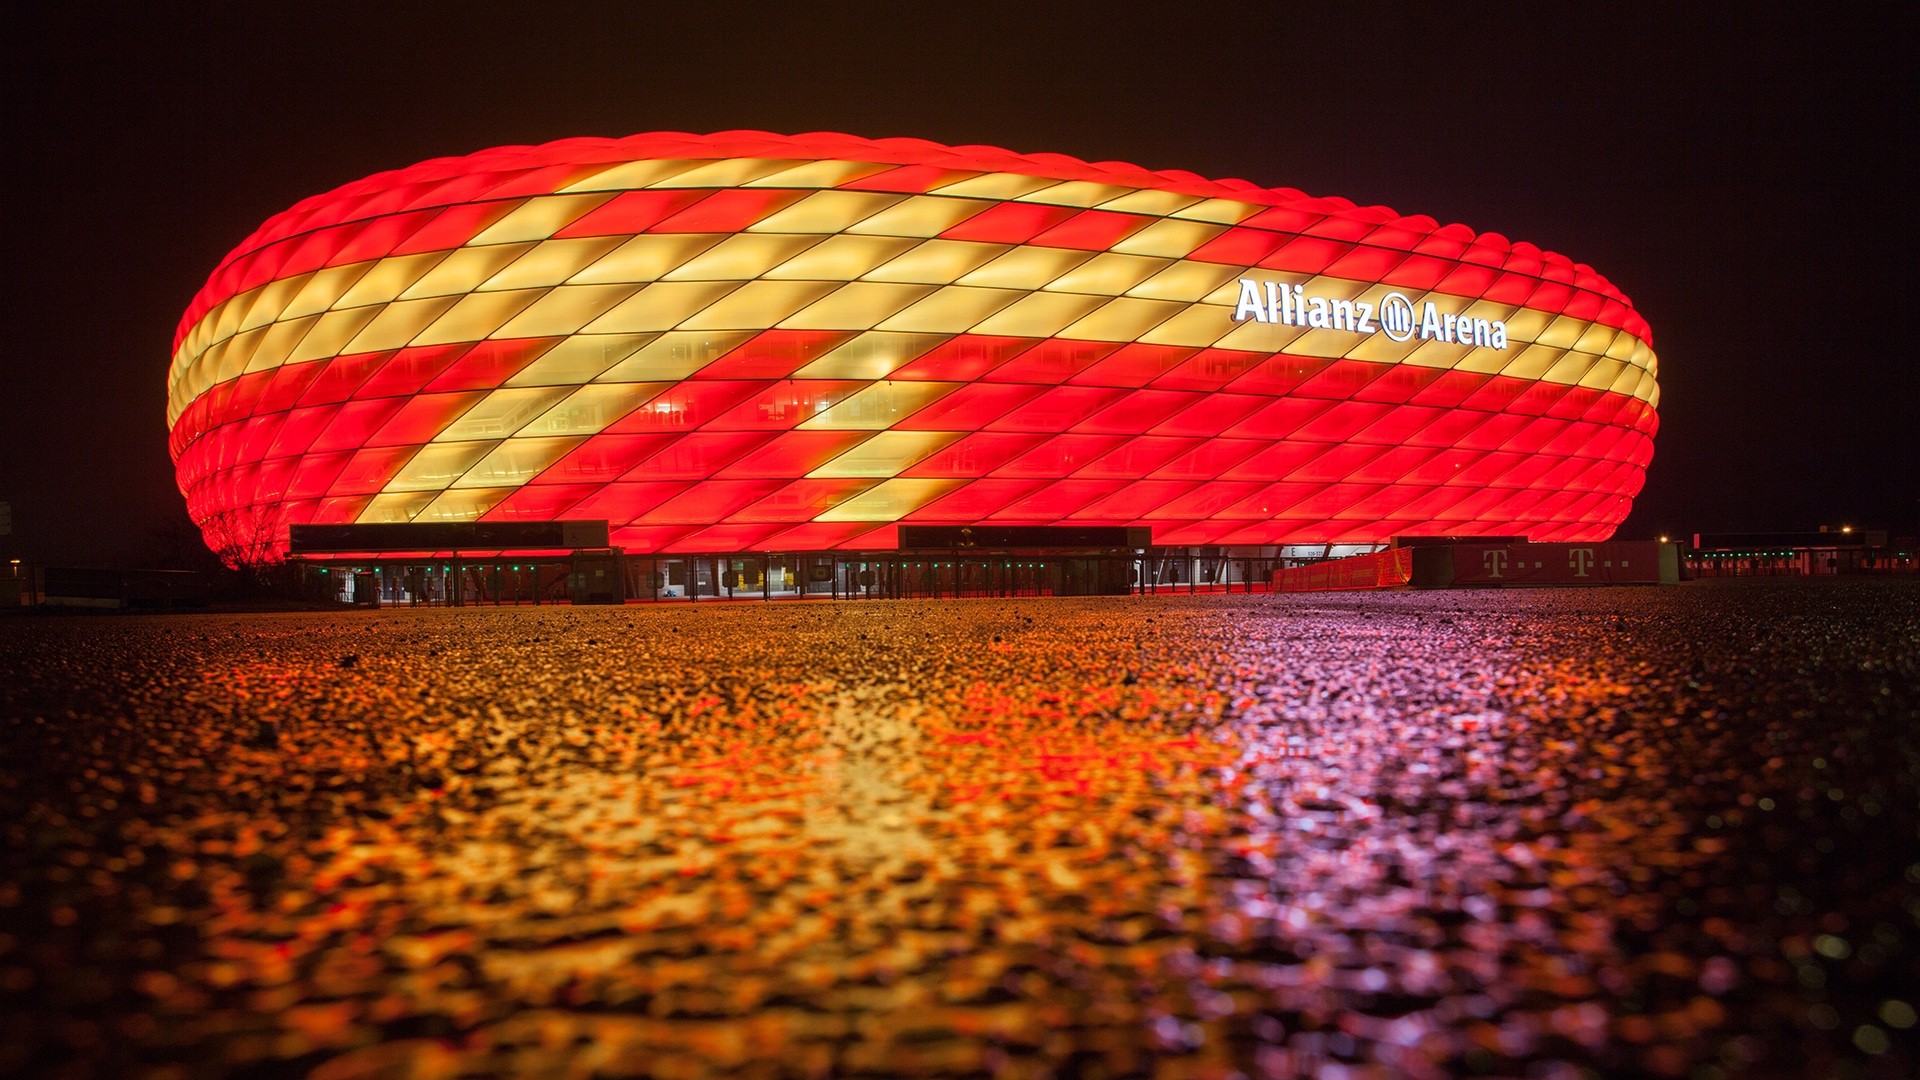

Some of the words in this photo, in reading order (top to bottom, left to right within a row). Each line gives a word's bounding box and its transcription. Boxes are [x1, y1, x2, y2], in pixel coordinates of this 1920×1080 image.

[1235, 278, 1376, 334] Allianz
[1420, 301, 1508, 350] Arena
[1291, 547, 1296, 556] E
